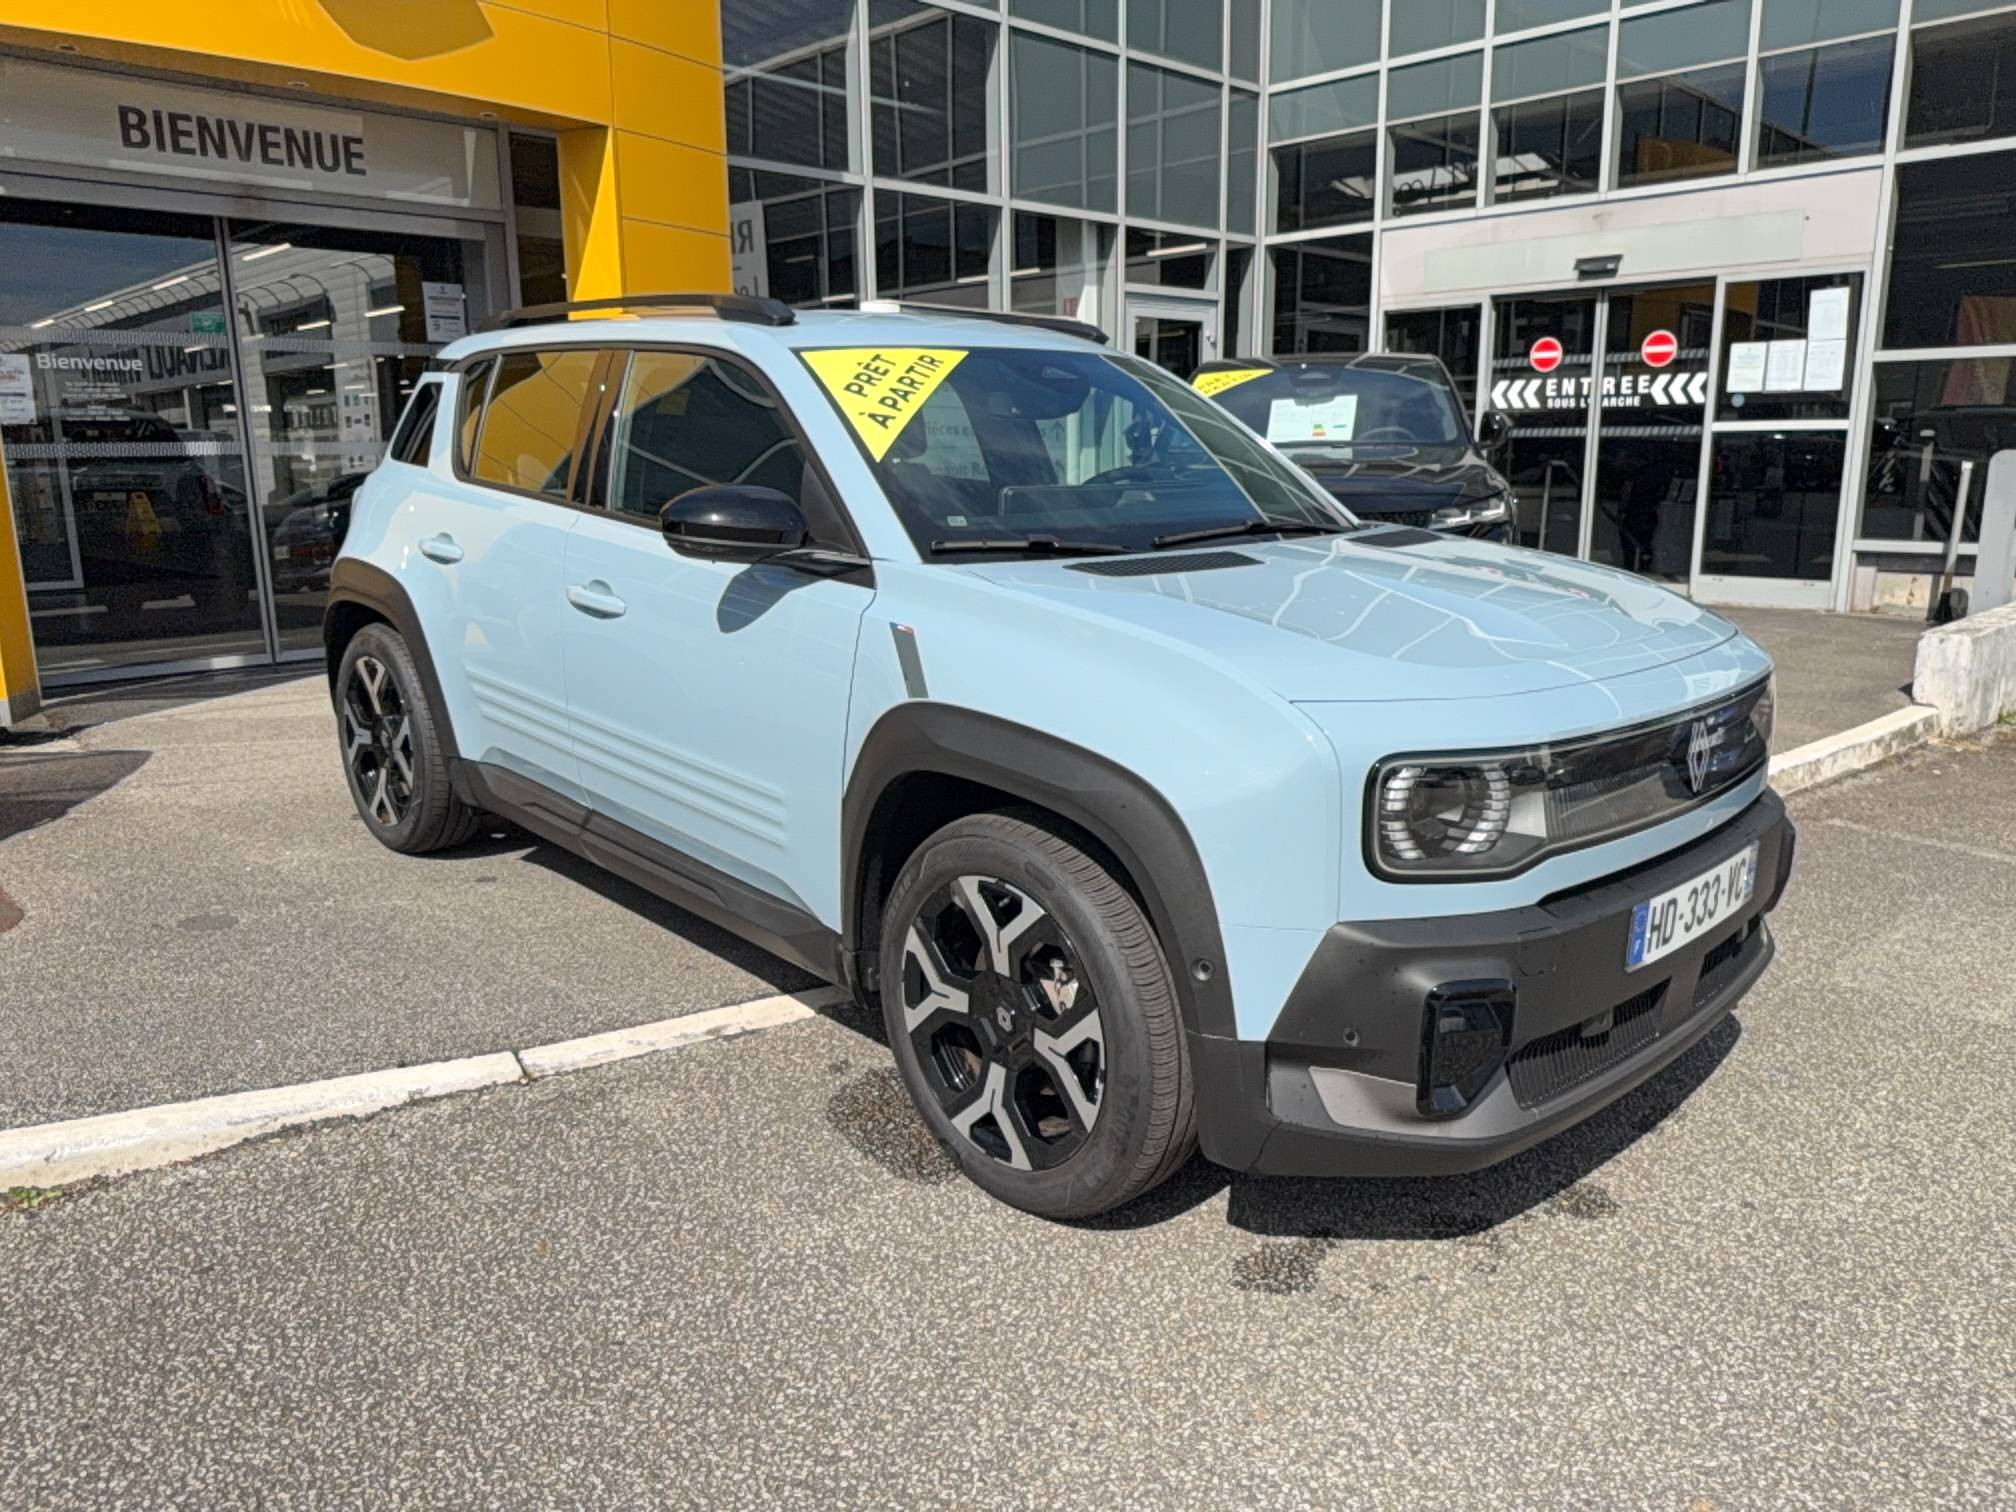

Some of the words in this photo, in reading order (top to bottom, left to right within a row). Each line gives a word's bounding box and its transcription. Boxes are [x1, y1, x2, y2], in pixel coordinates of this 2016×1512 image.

[117, 104, 367, 176] BIENVENUE
[35, 353, 143, 371] Bienvenue
[843, 353, 897, 398] PRÊT
[858, 411, 897, 430] À
[878, 354, 945, 413] PARTIR
[1545, 374, 1651, 397] ENTREE
[1547, 397, 1576, 409] SOUS
